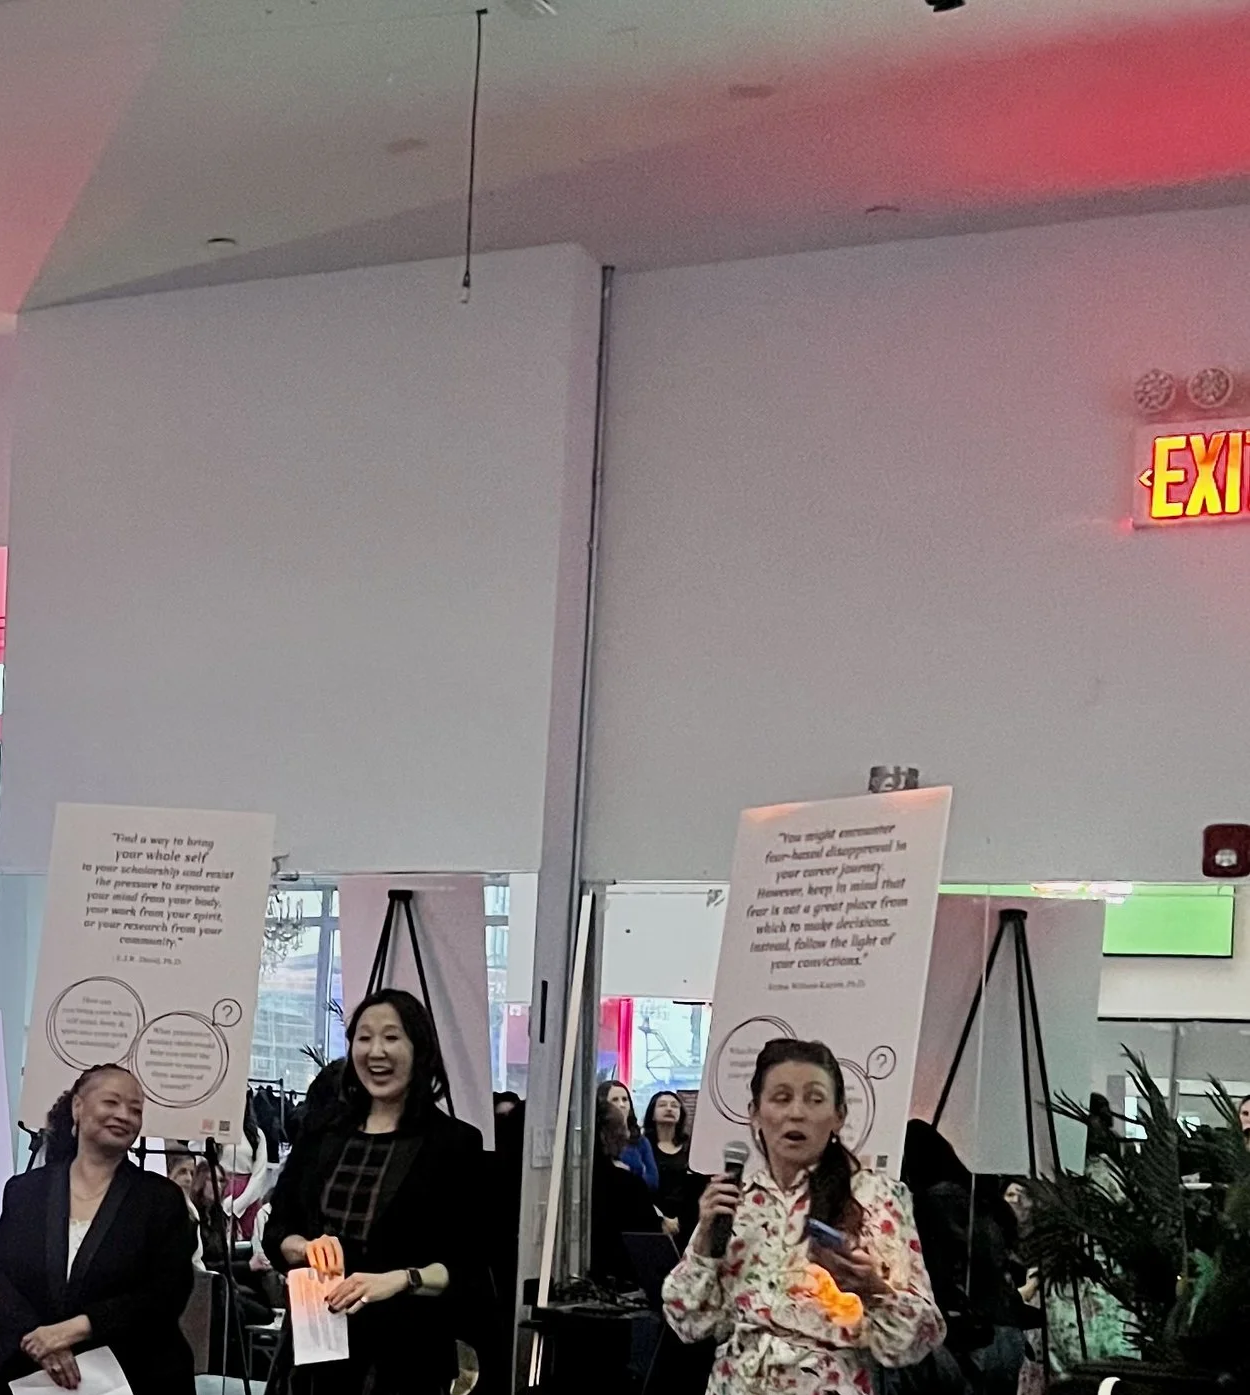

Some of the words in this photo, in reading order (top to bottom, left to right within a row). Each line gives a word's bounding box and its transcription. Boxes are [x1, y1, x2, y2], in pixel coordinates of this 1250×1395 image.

[1151, 431, 1250, 518] EXI
[174, 837, 183, 845] to
[116, 850, 143, 862] your
[146, 851, 180, 861] whole
[185, 852, 209, 863] self
[83, 863, 92, 871] to
[162, 881, 171, 890] to
